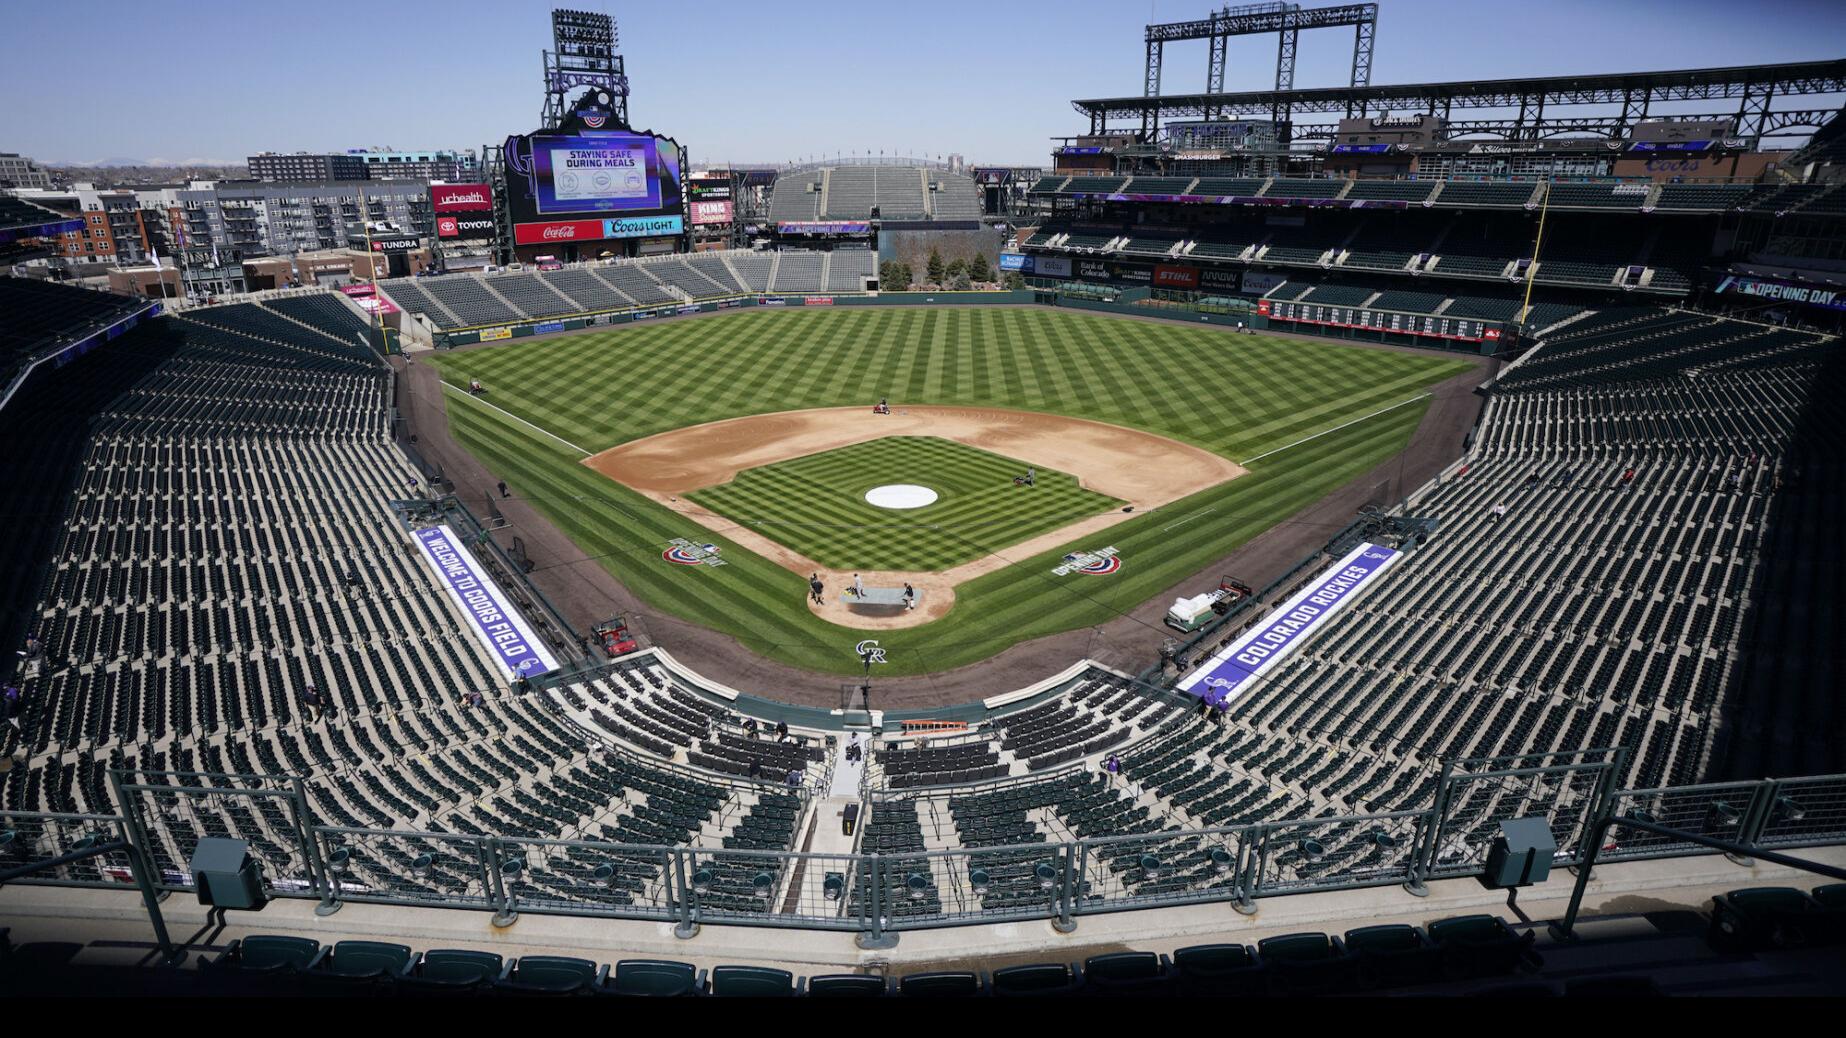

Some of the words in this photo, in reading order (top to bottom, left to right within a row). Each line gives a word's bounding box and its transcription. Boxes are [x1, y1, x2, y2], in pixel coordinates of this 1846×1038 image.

[570, 150, 608, 159] STAYING
[610, 150, 632, 159] SAFE
[566, 159, 602, 168] DURING
[604, 159, 635, 167] MEALS
[1647, 159, 1699, 171] Coors
[441, 191, 484, 204] uchealth
[698, 202, 725, 213] KING
[457, 220, 494, 230] TOYOTA
[611, 219, 645, 233] Coors
[645, 221, 674, 231] LIGHT
[381, 240, 418, 250] TUNDRA
[1080, 262, 1097, 270] Bank
[1097, 262, 1105, 270] of
[1080, 268, 1110, 279] Colorado
[1159, 271, 1193, 282] STIHL
[1201, 271, 1238, 282] ARROW
[1755, 282, 1810, 302] OPENING
[1809, 288, 1838, 305] DAY
[427, 537, 469, 578] WELCOME
[454, 575, 477, 591] TO
[463, 588, 501, 624] COORS
[1236, 603, 1321, 667] COLORADO
[1313, 565, 1369, 607] ROCKIES
[487, 622, 528, 658] FIELD
